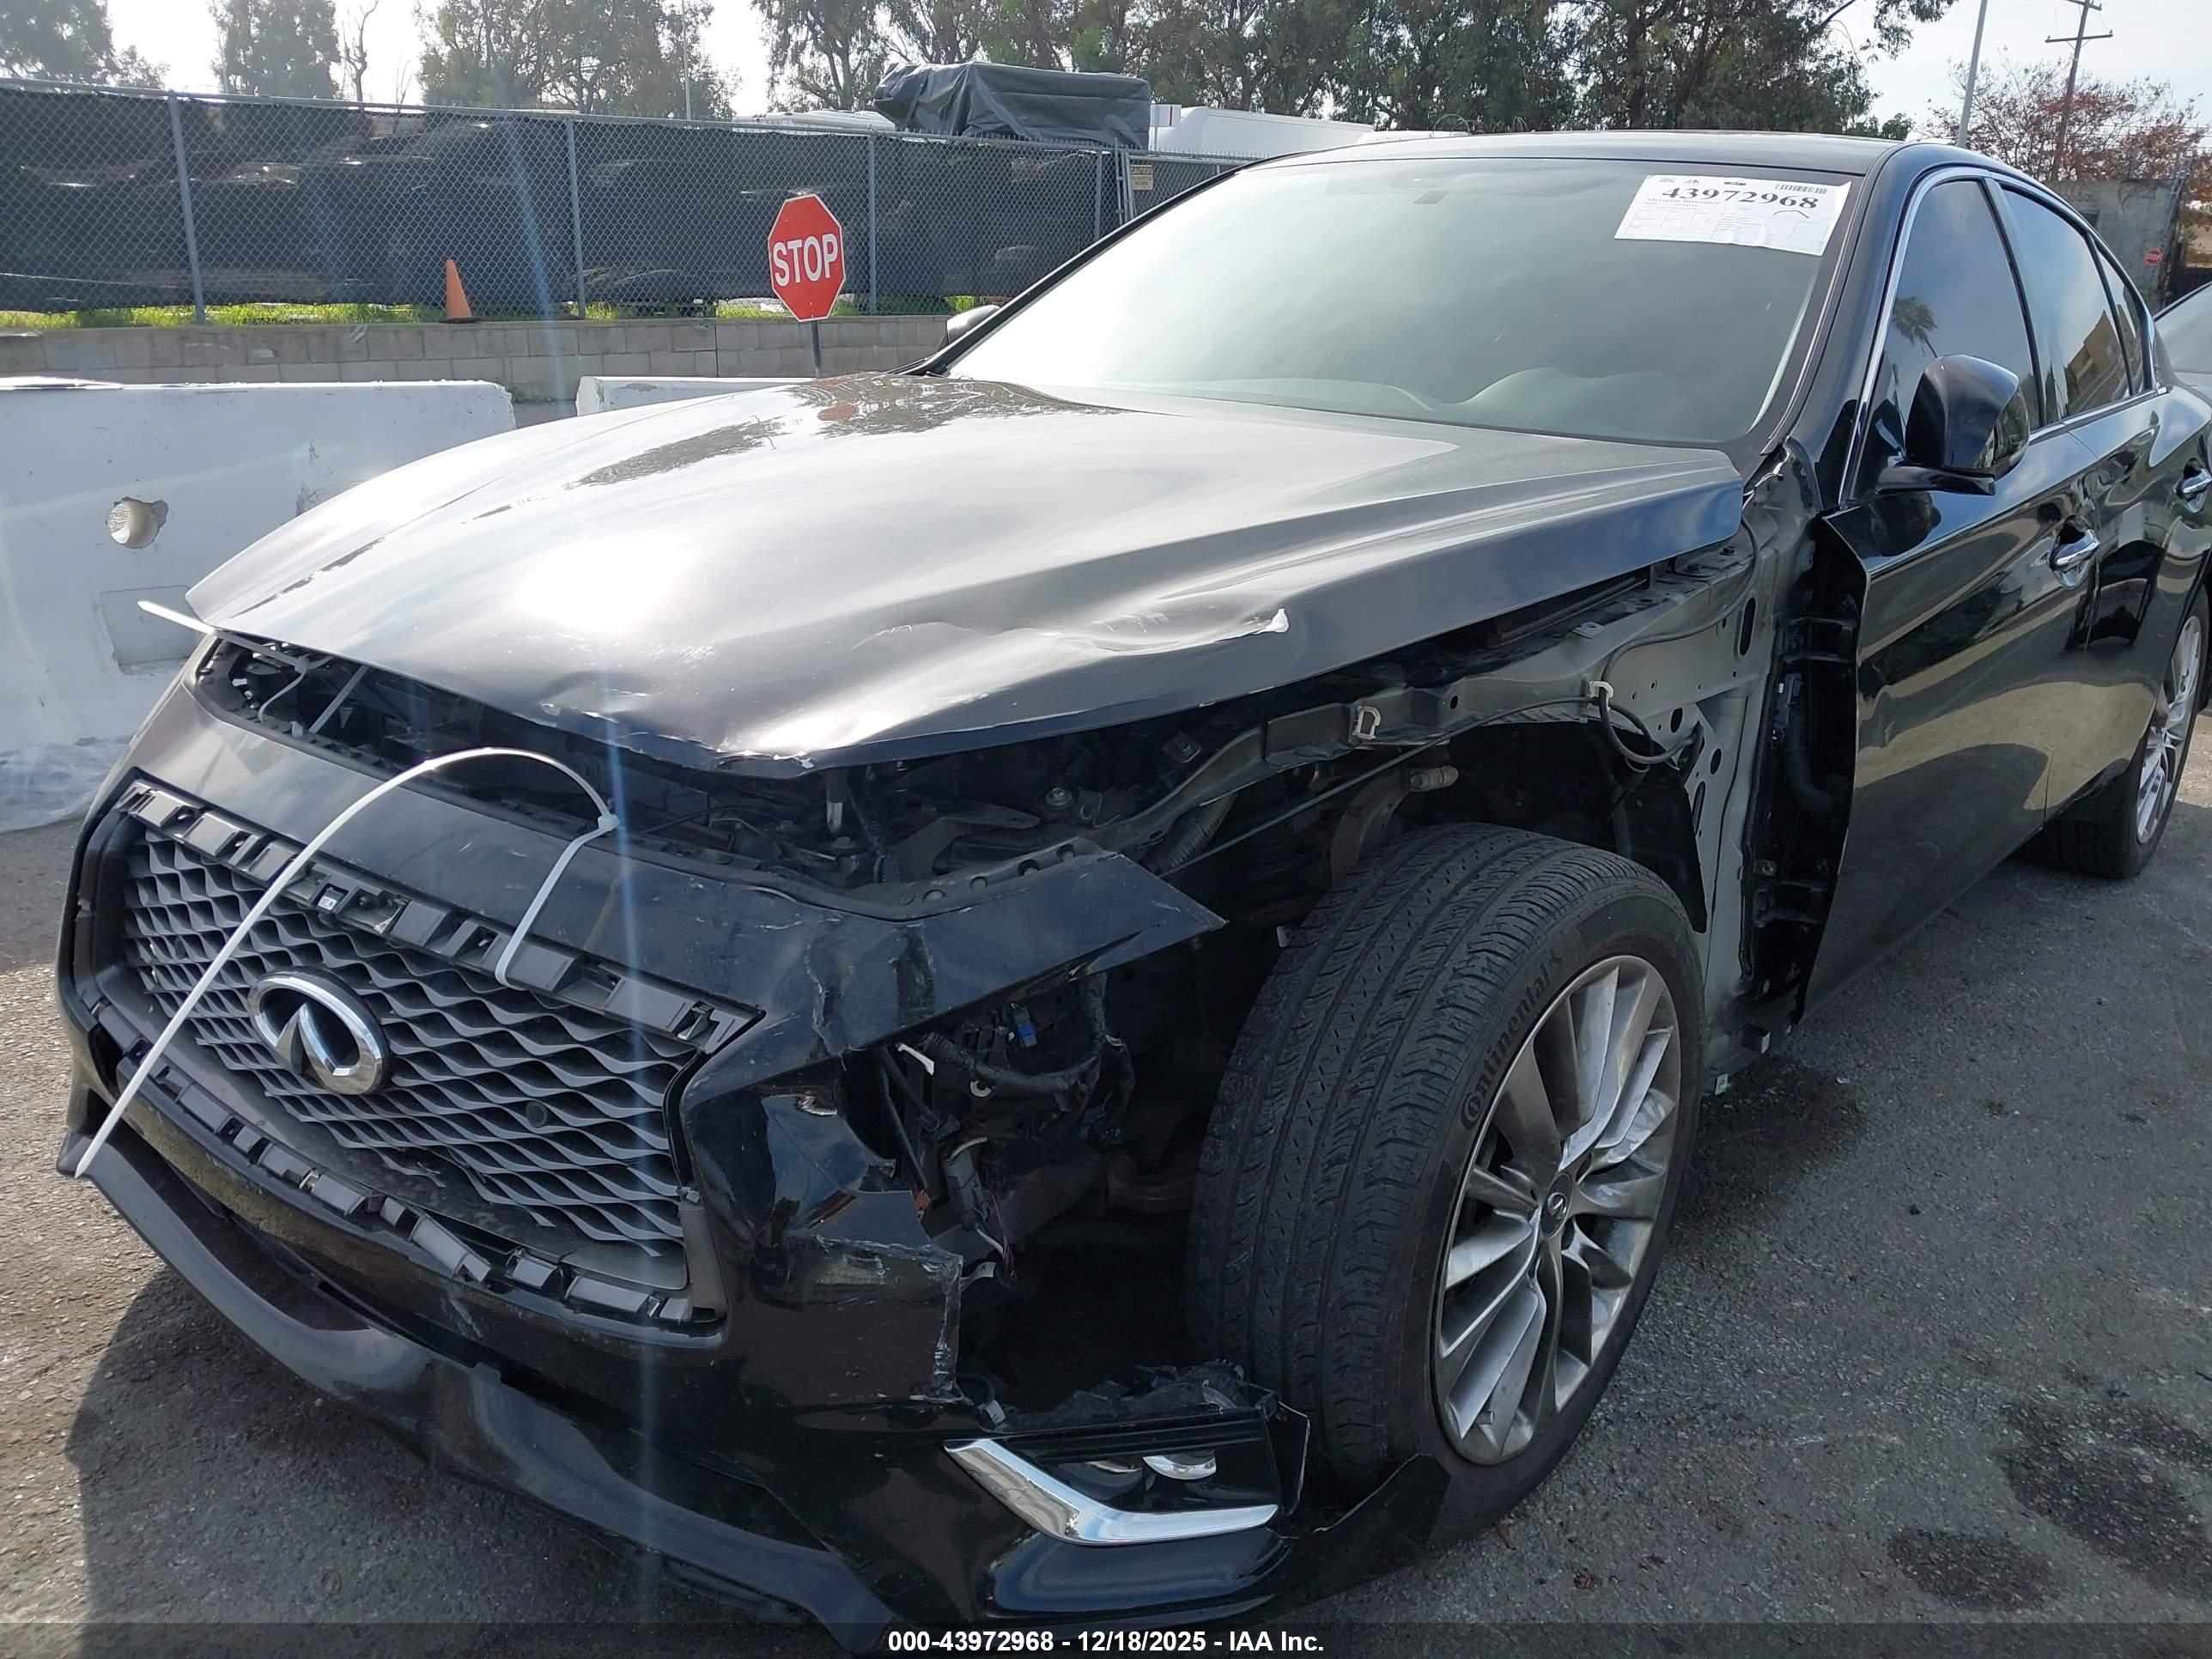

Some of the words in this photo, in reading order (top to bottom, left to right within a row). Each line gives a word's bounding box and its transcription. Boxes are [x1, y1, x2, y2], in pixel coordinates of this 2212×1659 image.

[1662, 186, 1819, 210] 43972968
[773, 233, 839, 287] STOP
[1460, 963, 1553, 1131] Continental
